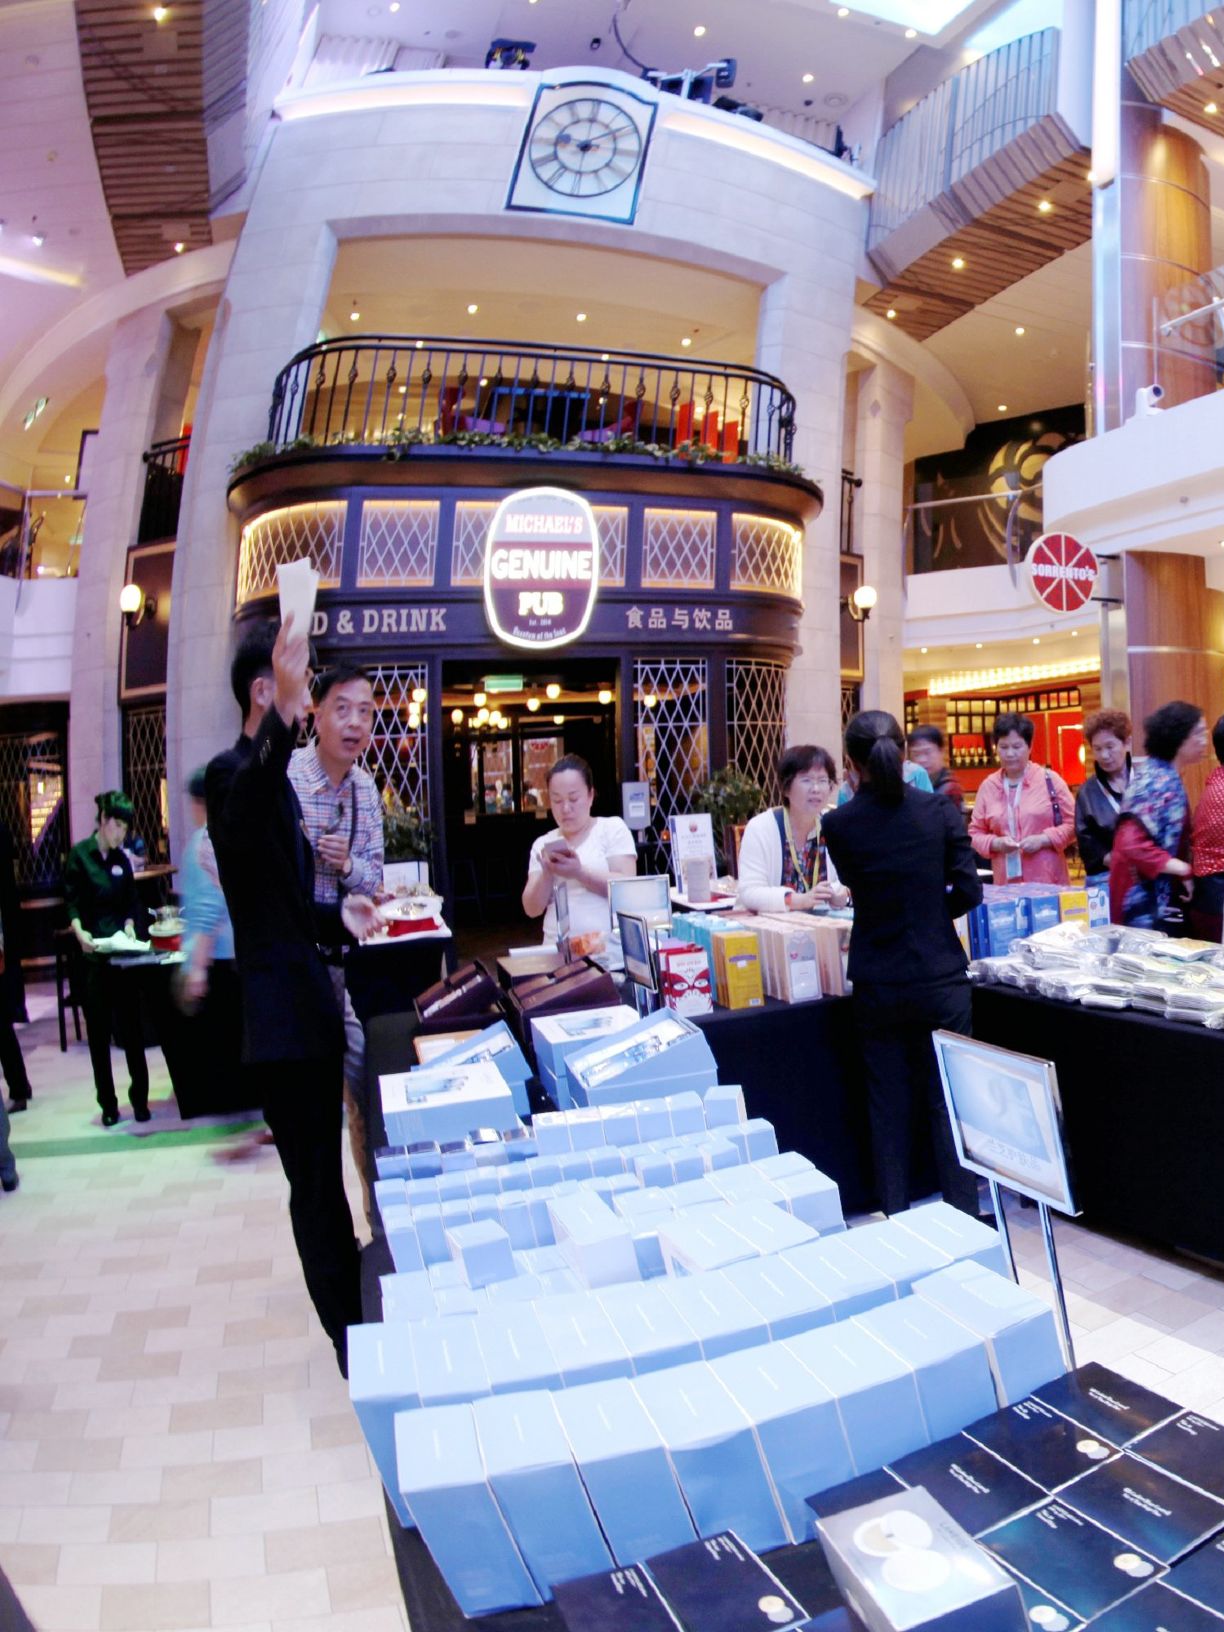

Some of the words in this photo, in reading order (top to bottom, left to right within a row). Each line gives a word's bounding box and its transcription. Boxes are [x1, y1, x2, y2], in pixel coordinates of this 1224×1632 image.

[505, 512, 584, 534] MICHAEL'S
[491, 548, 593, 580] GENUINE
[518, 591, 564, 616] PUB
[336, 609, 354, 635] &
[362, 608, 447, 633] DRINK
[625, 604, 733, 631] 食品与饮品
